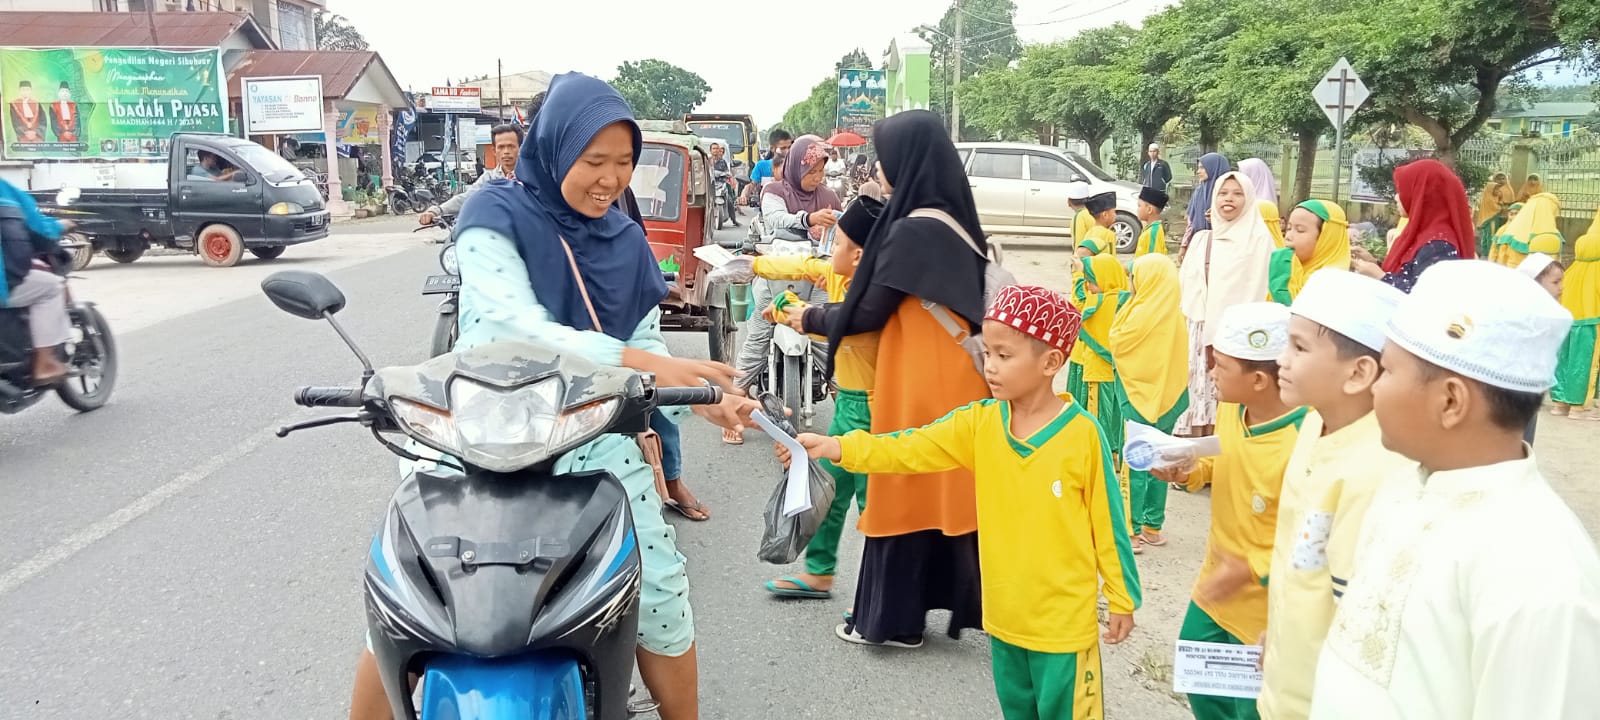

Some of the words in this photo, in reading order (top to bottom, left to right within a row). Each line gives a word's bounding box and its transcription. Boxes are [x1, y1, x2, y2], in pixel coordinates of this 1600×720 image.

[104, 56, 145, 66] Pengadilan
[148, 57, 175, 66] Negeri
[252, 95, 282, 104] YAYASAN
